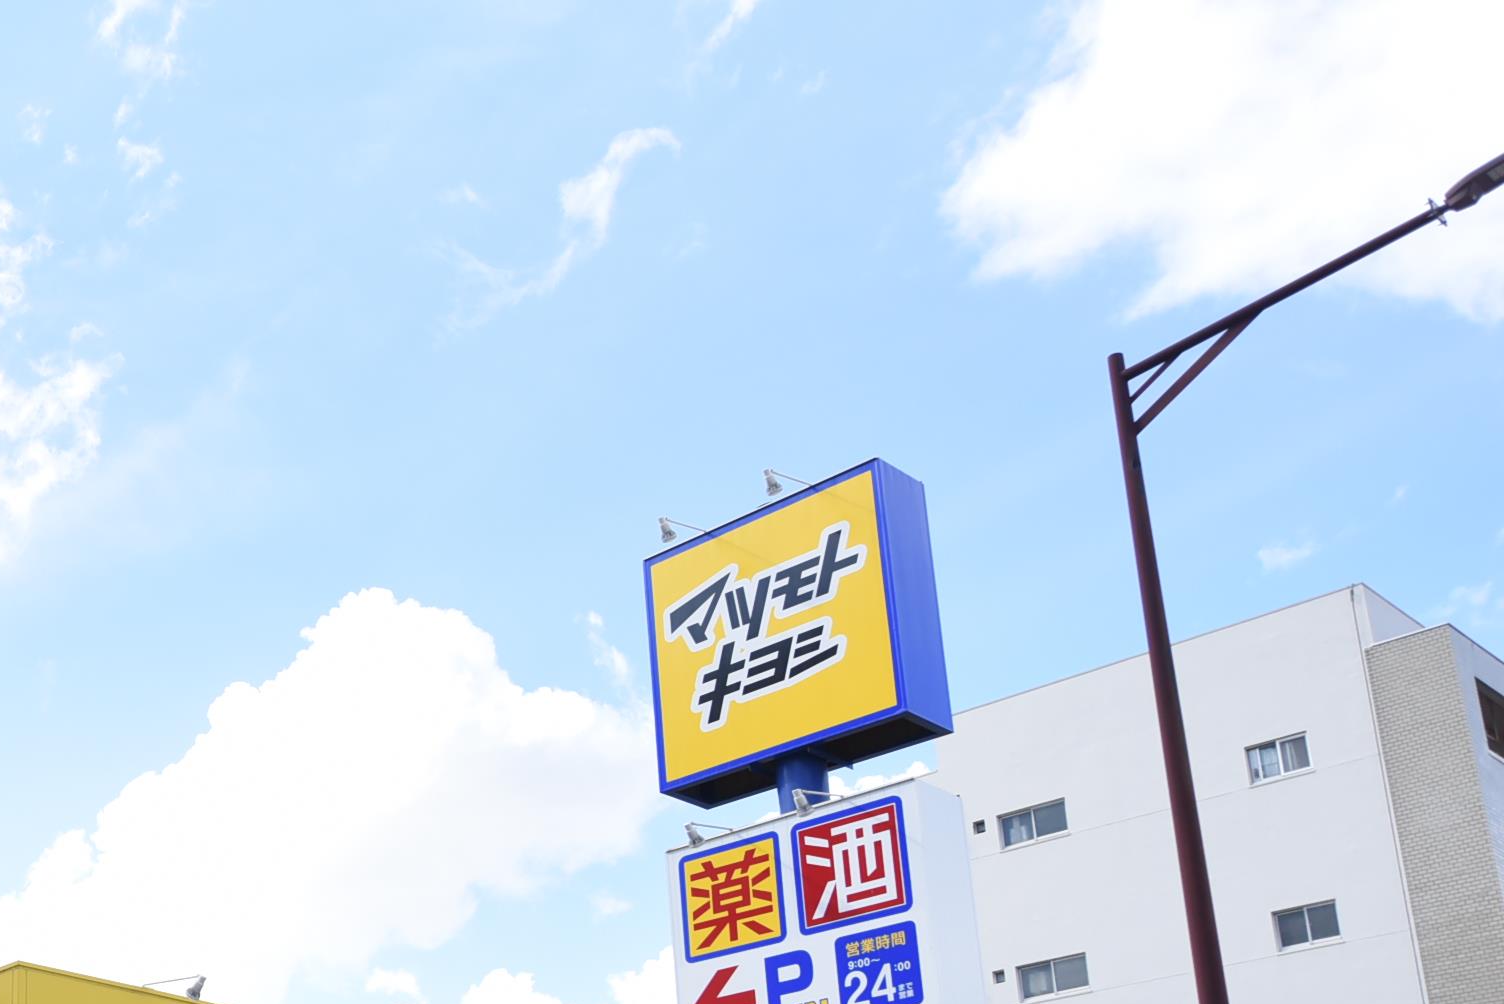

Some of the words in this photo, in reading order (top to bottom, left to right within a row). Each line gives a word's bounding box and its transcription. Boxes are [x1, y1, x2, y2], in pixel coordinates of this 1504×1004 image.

[667, 527, 861, 644] マツモト
[697, 623, 839, 724] キヨシ
[690, 848, 775, 950] 薬
[804, 813, 901, 921] 酒
[846, 931, 907, 958] 営業時間
